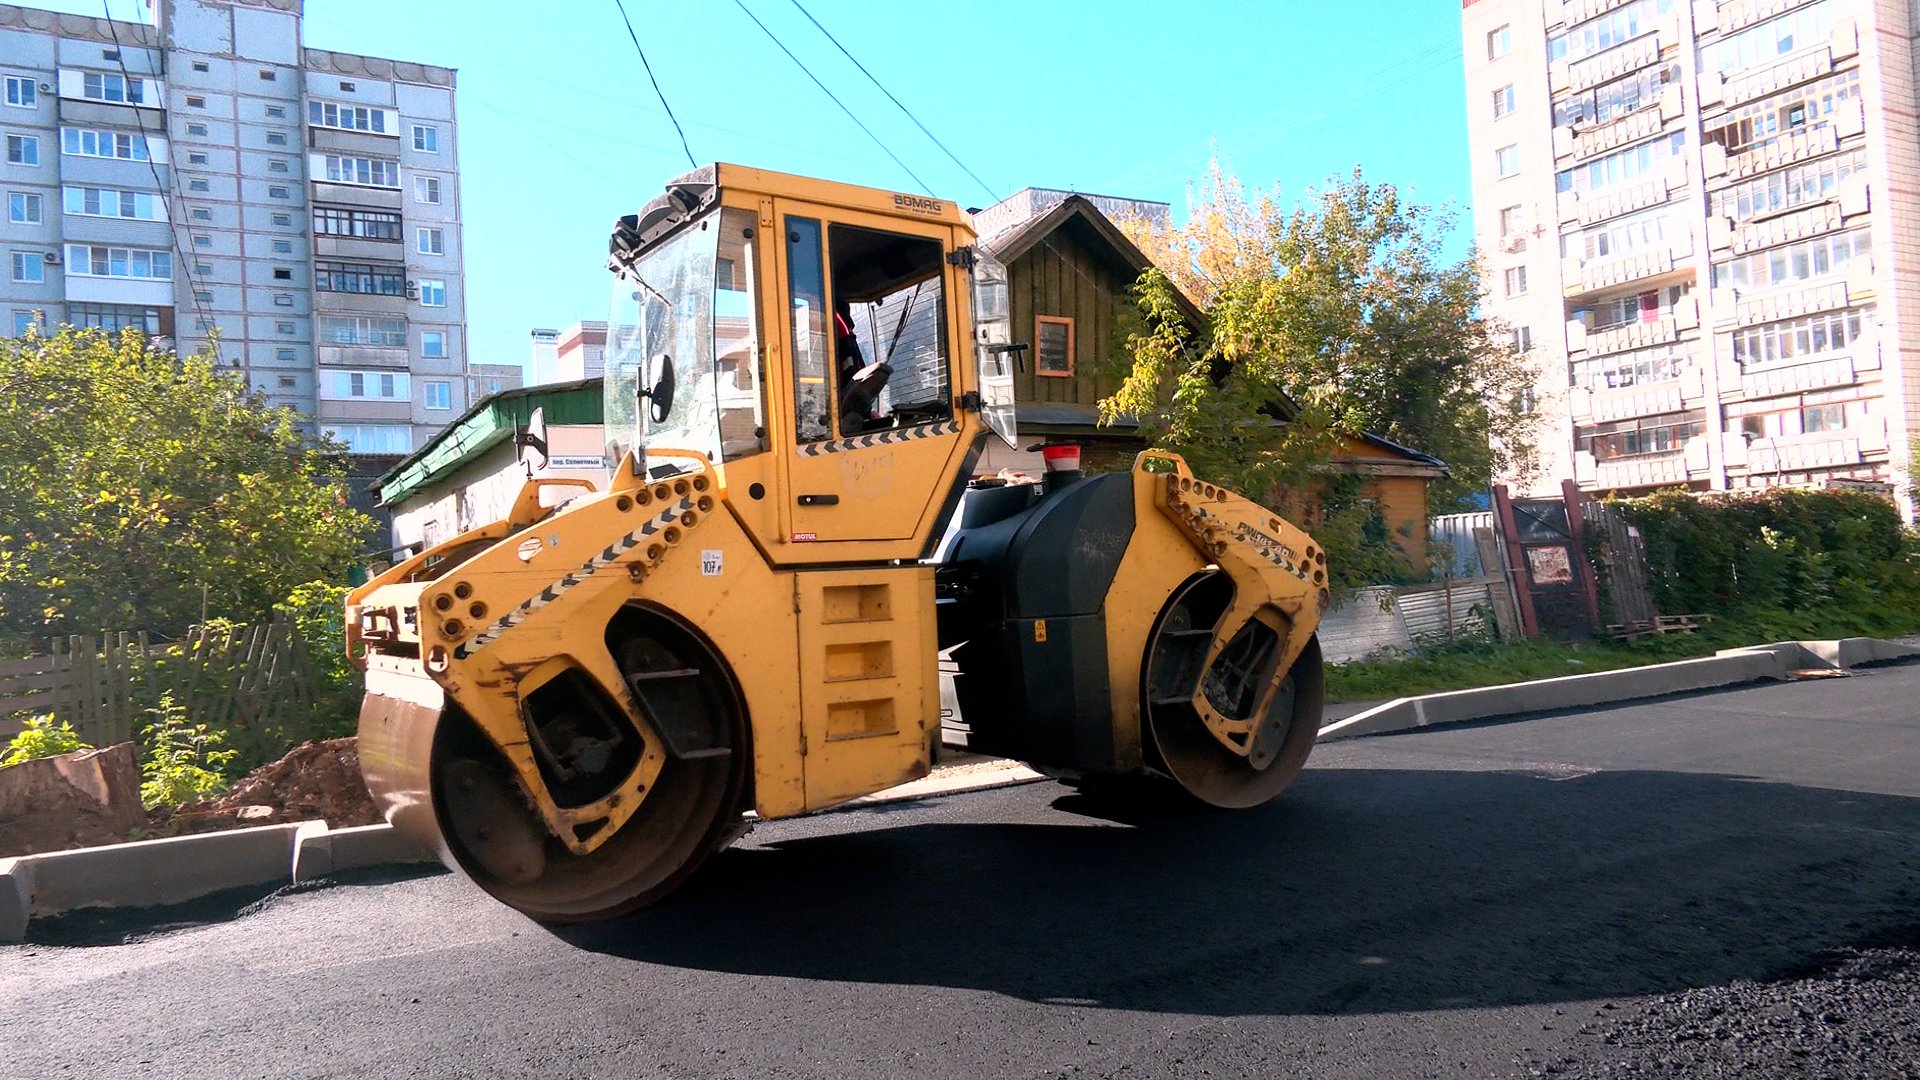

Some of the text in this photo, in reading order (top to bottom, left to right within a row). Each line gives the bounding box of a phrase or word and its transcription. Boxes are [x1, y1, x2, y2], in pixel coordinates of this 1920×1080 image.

[894, 194, 941, 211] BOMAG
[793, 533, 817, 541] MOTUL
[703, 560, 716, 574] 107
